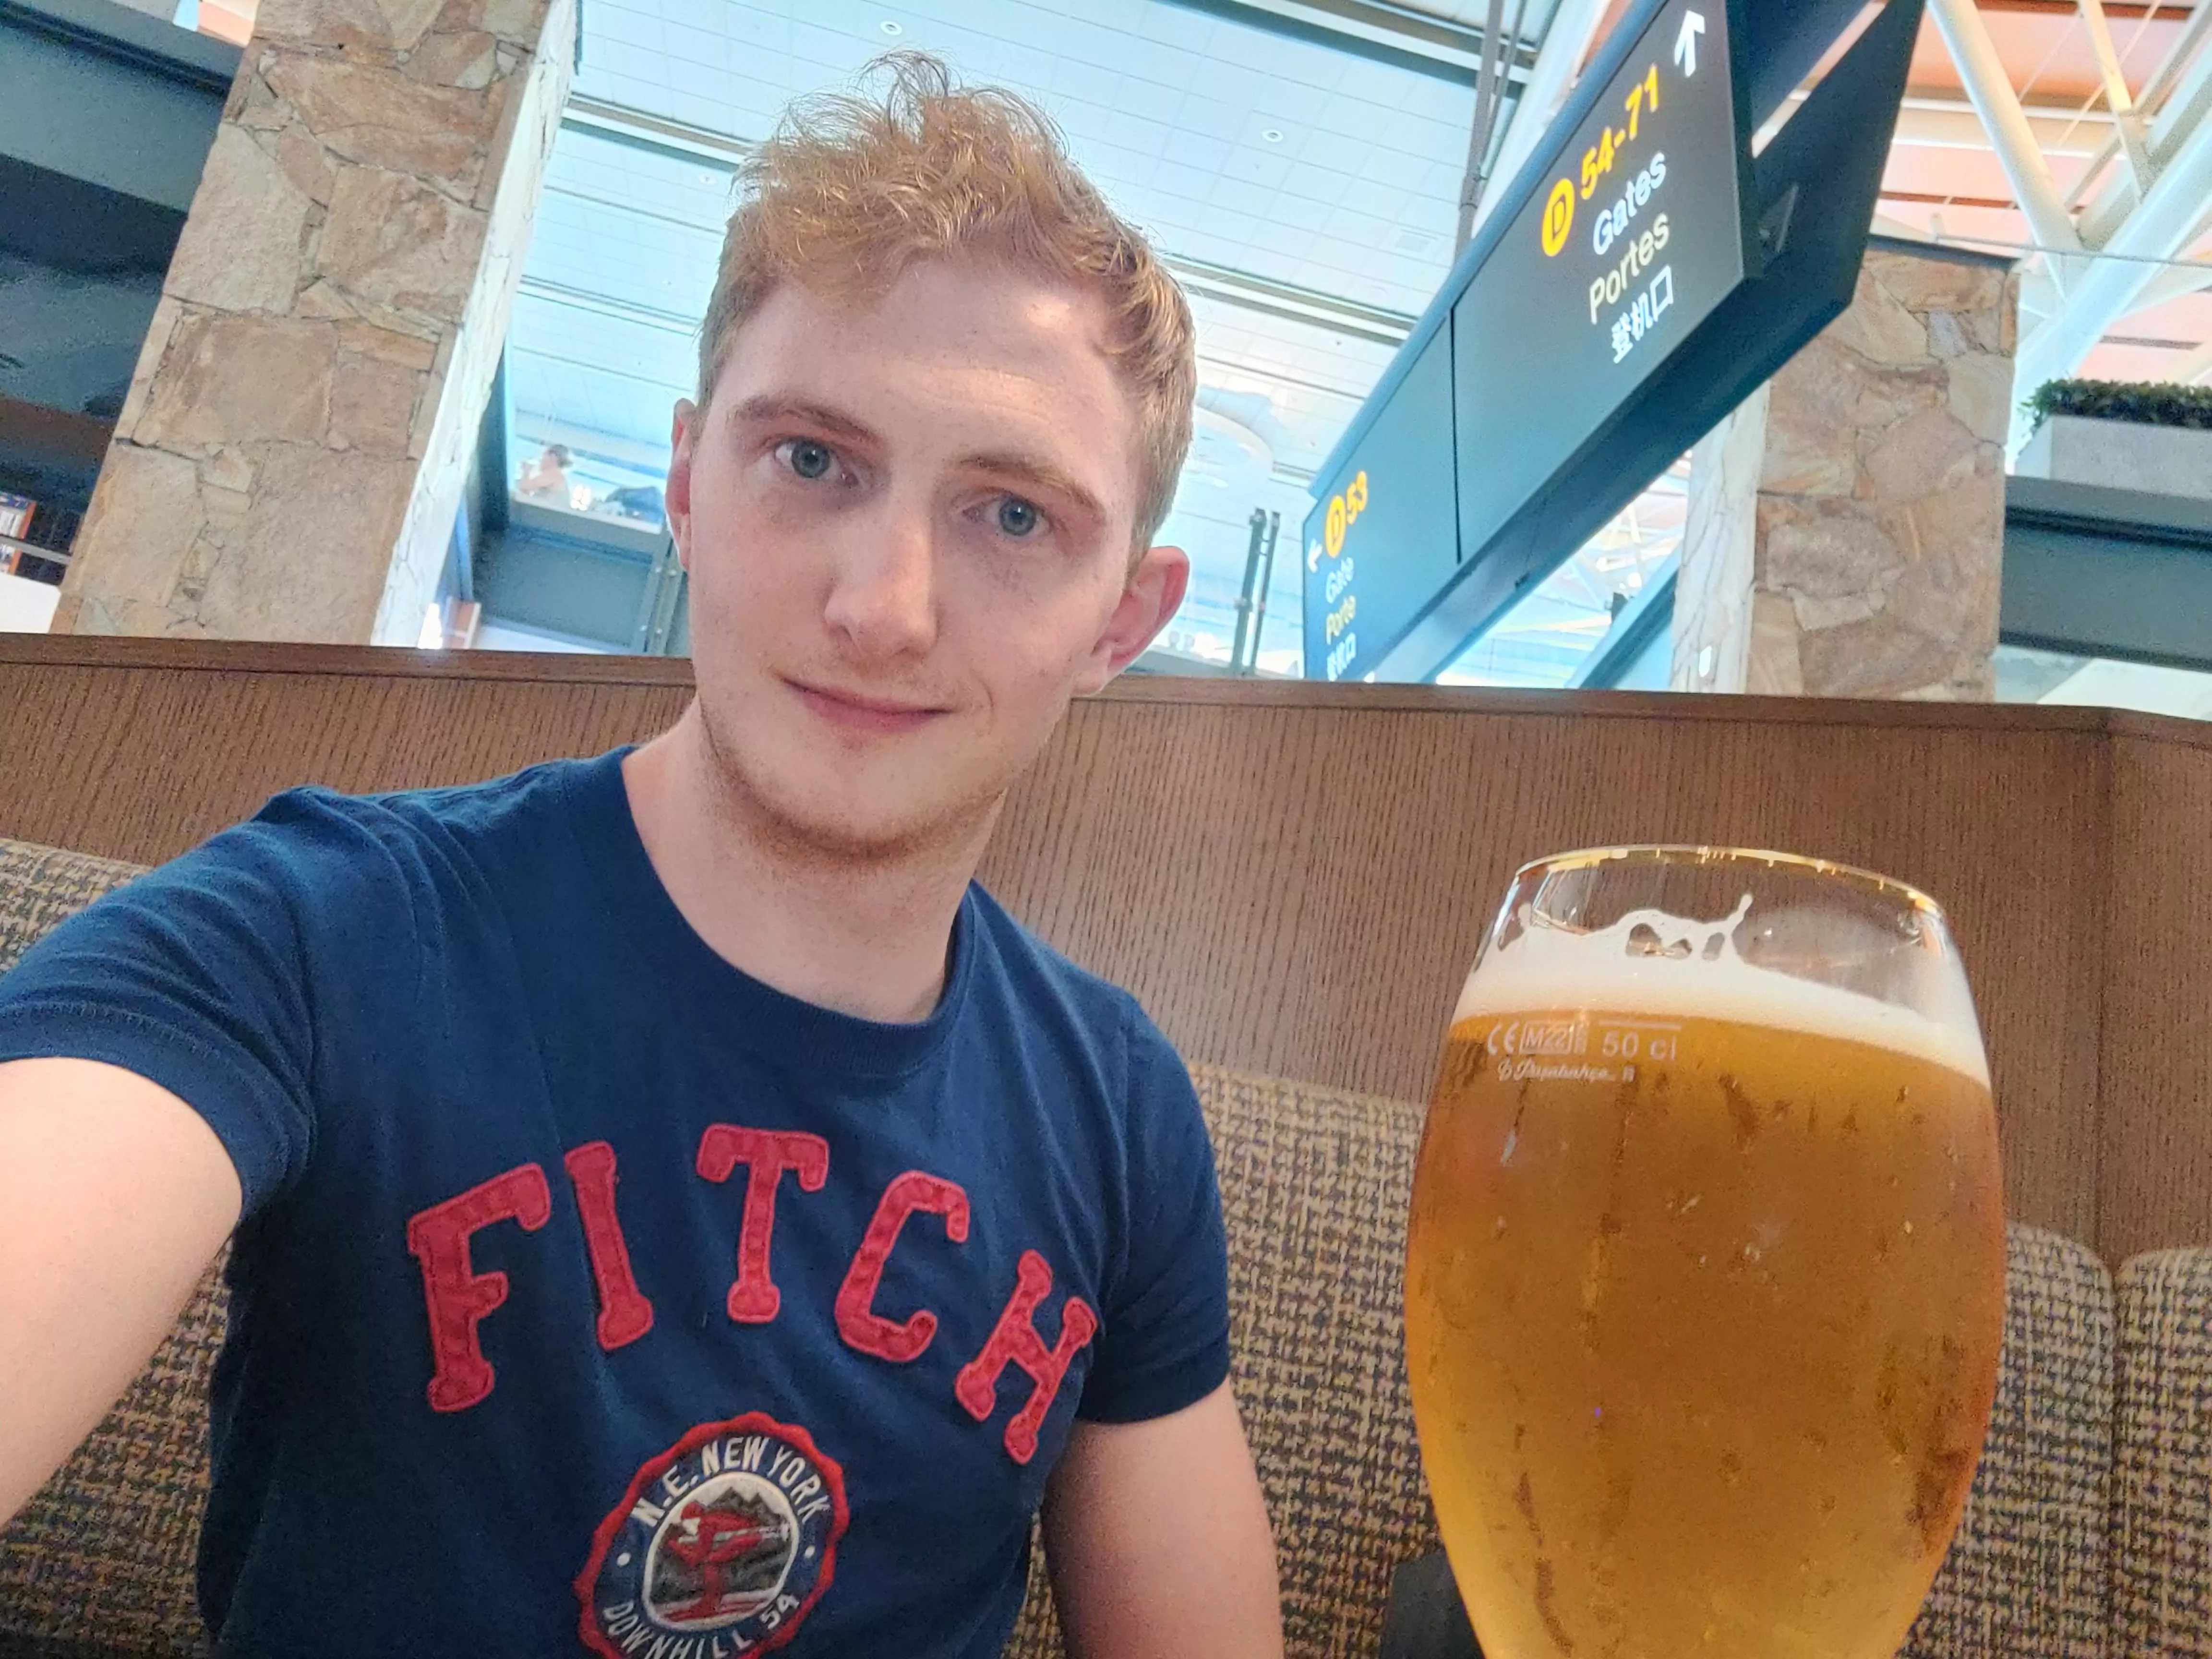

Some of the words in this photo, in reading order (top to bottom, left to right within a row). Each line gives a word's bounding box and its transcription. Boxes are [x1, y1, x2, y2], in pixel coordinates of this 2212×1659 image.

[1581, 63, 1659, 199] 54-71
[1593, 151, 1667, 255] Gates
[1589, 212, 1670, 325] Portes
[1611, 264, 1674, 364] 登机口
[1346, 471, 1368, 525] 53
[1326, 557, 1354, 603] Gate
[1326, 595, 1355, 645] Porte
[1603, 1030, 1639, 1058] 50
[1649, 1034, 1677, 1061] cl
[407, 1123, 1098, 1465] FITCH
[701, 1436, 769, 1477] NEW
[767, 1444, 832, 1525] YORK
[603, 1599, 754, 1659] DOWNHILL
[758, 1593, 800, 1629] 54
